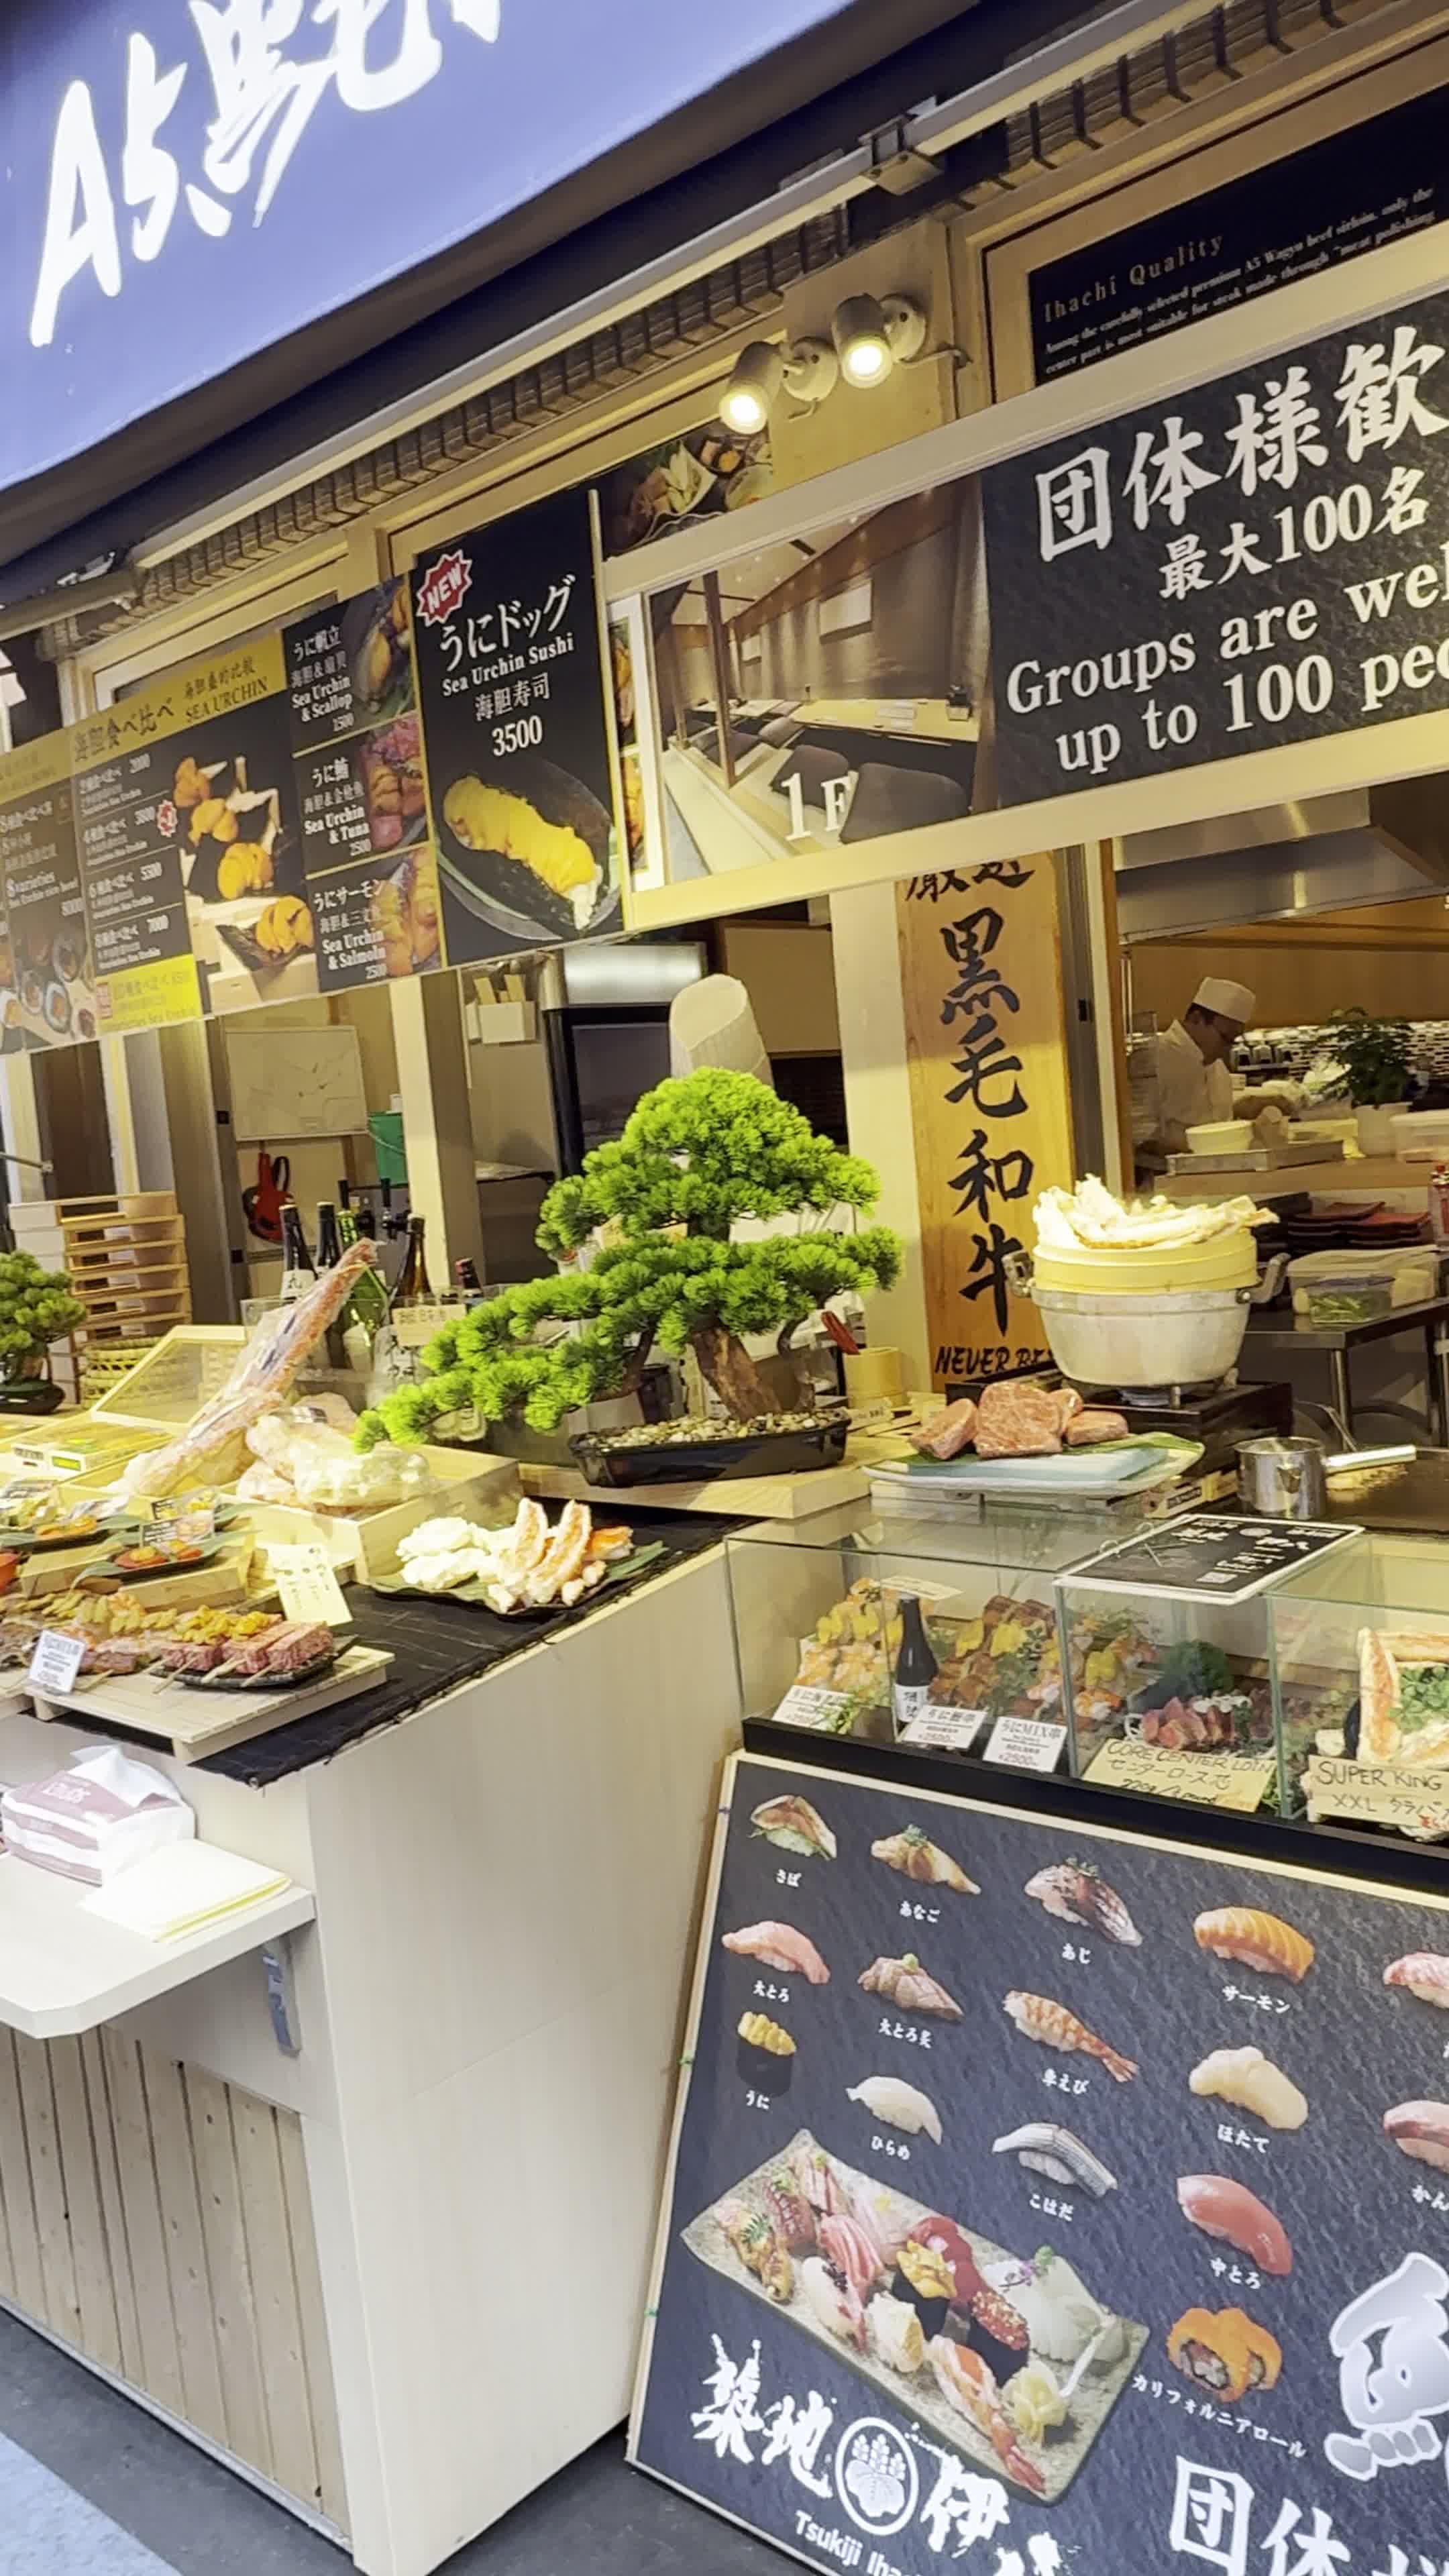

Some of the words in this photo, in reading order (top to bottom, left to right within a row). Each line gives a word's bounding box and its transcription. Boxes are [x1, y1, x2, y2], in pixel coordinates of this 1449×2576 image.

[1244, 256, 1262, 271] A5
[1264, 242, 1304, 264] Wagyu
[1306, 225, 1334, 248] beef
[1044, 275, 1117, 323] Ihachi
[1129, 235, 1223, 286] Quality
[1035, 325, 1449, 562] 団体様歓
[1159, 466, 1431, 600] 最大100名
[427, 562, 463, 614] NEW
[440, 574, 576, 672] うにドッグ
[442, 676, 469, 696] Sea
[472, 653, 525, 685] Urchin
[528, 632, 574, 665] Sushi
[1006, 631, 1196, 714] Groups
[1218, 597, 1318, 659] are
[292, 692, 311, 708] Sea
[311, 674, 352, 700] Urchin
[311, 693, 353, 718] Scallop
[475, 672, 550, 722] 海胆寿司
[1056, 722, 1121, 775] up
[1141, 700, 1198, 751] to
[1224, 653, 1335, 733] 100
[492, 715, 543, 757] 3500
[305, 819, 325, 835] Sea
[325, 804, 366, 828] Urchin
[339, 822, 370, 841] Tuna
[321, 938, 343, 955] Sea
[343, 927, 385, 949] Urchin
[940, 906, 1034, 1337] 黒毛和牛
[934, 1346, 1010, 1375] NEVER
[1107, 1741, 1154, 1761] CORE
[1157, 1750, 1228, 1770] CENTER
[1318, 1760, 1387, 1787] SUPER
[1393, 1770, 1442, 1791] KING
[1332, 1793, 1377, 1813] XXL
[775, 1868, 803, 1888] さば
[899, 1900, 941, 1923] あなご
[1061, 1943, 1091, 1964] あじ
[1222, 1984, 1291, 2014] サーモン
[744, 2090, 771, 2110] うに
[870, 2135, 911, 2161] ひらめ
[1217, 2123, 1271, 2154] ほたて
[1028, 2193, 1075, 2222] こはだ
[1210, 2256, 1262, 2290] 中とろ
[1131, 2373, 1307, 2459] カリフォルニアロール
[794, 2510, 864, 2567] Tsukiji
